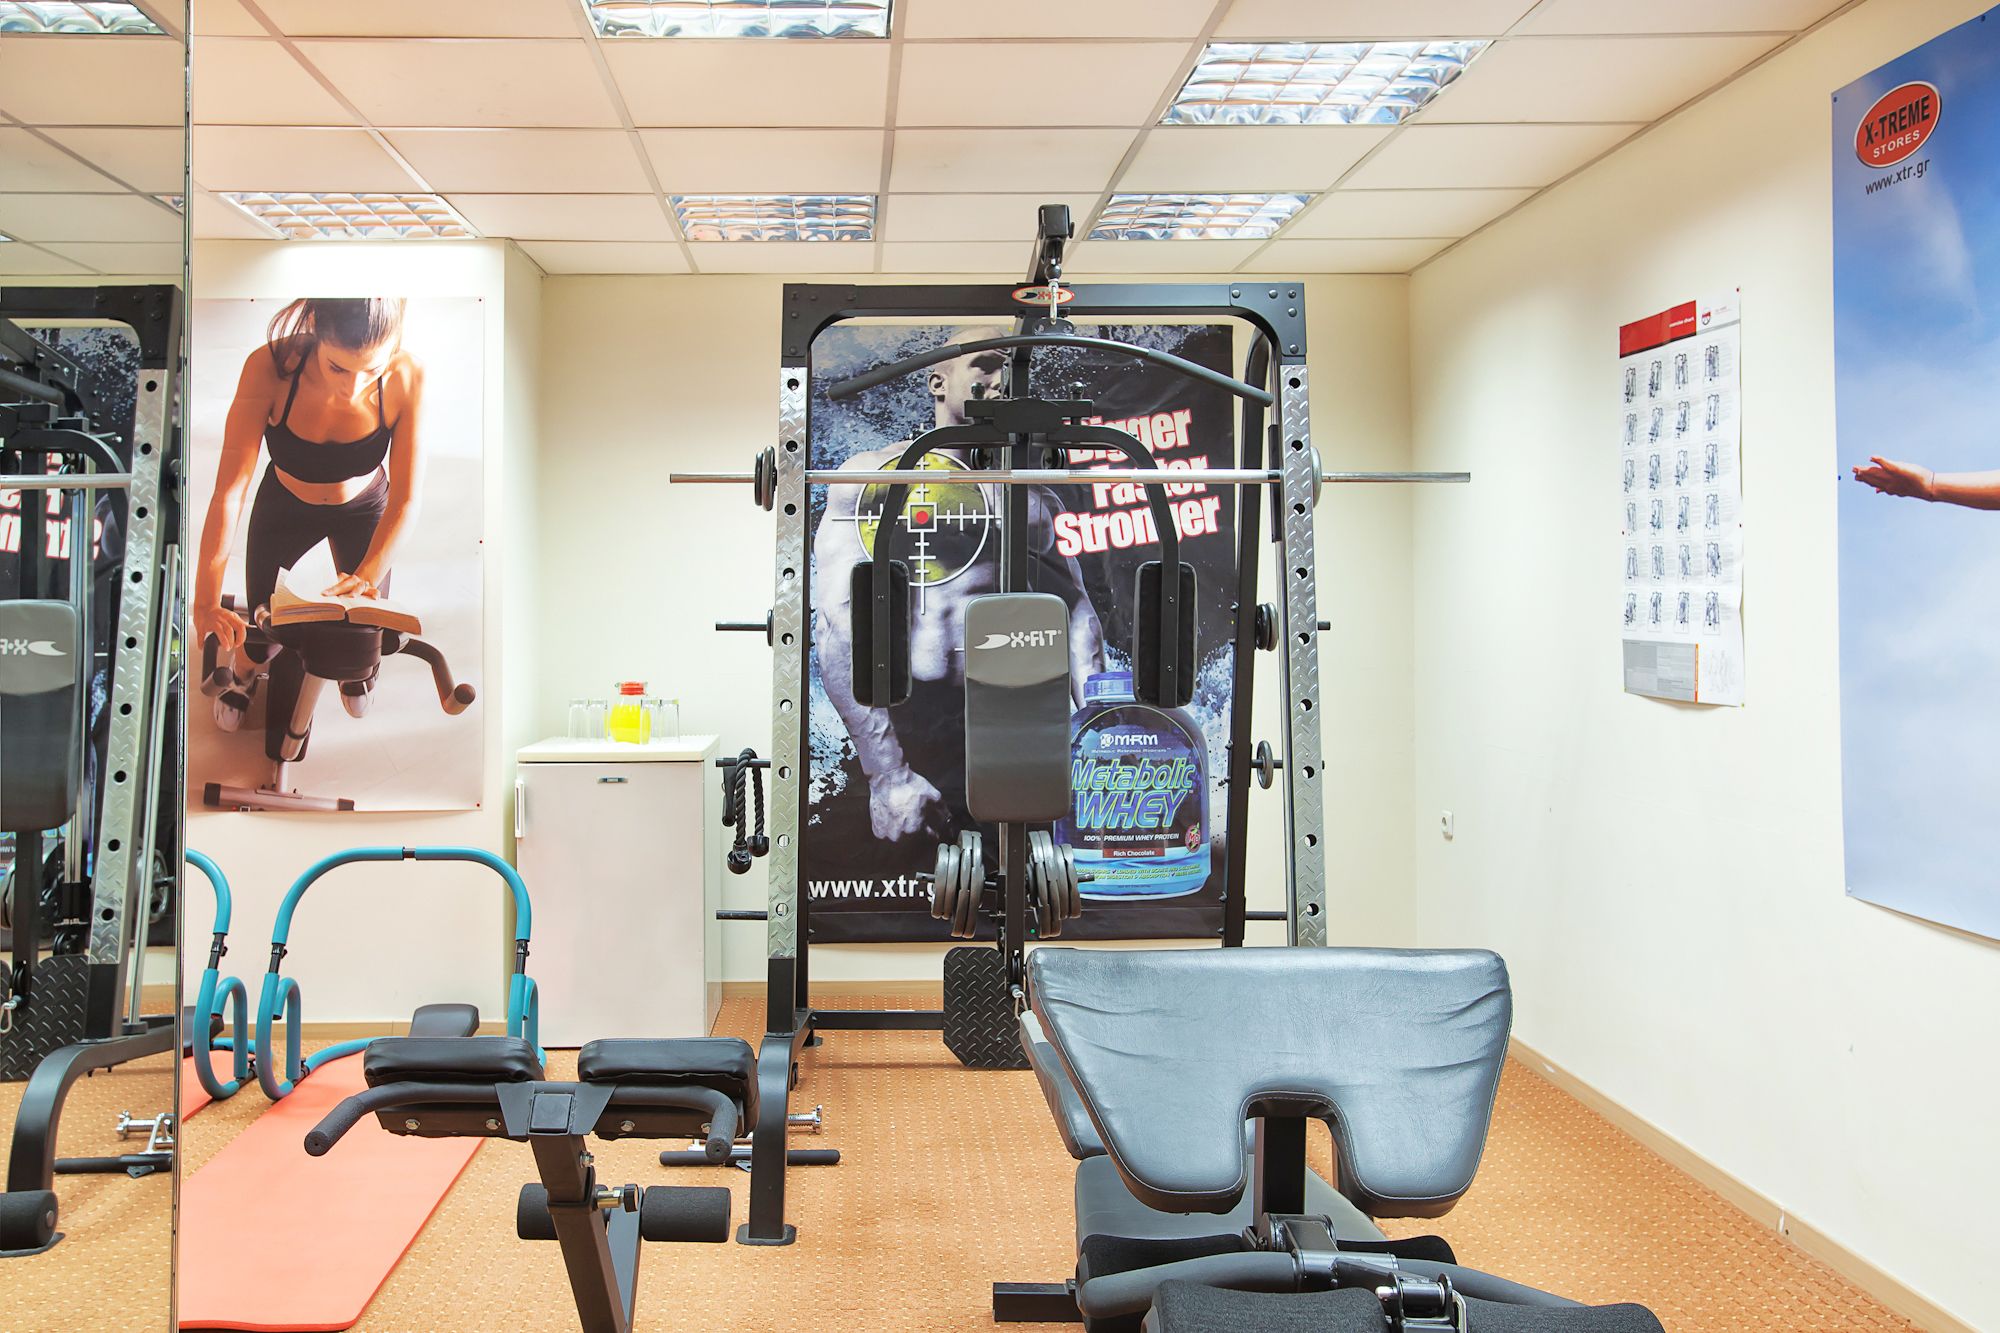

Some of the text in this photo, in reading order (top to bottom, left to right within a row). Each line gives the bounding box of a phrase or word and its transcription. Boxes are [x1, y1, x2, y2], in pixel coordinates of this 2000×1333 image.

[1865, 95, 1930, 147] X-TREME
[1873, 129, 1920, 158] STORES
[1865, 158, 1930, 195] www.xtr.gr
[1067, 408, 1192, 464] ger
[1090, 455, 1209, 509] Faer
[1054, 496, 1221, 557] Stroner
[1114, 734, 1158, 746] MRM
[1072, 758, 1196, 790] Metabolic
[1076, 789, 1188, 829] WHEY
[808, 874, 936, 903] www.xtr.g
